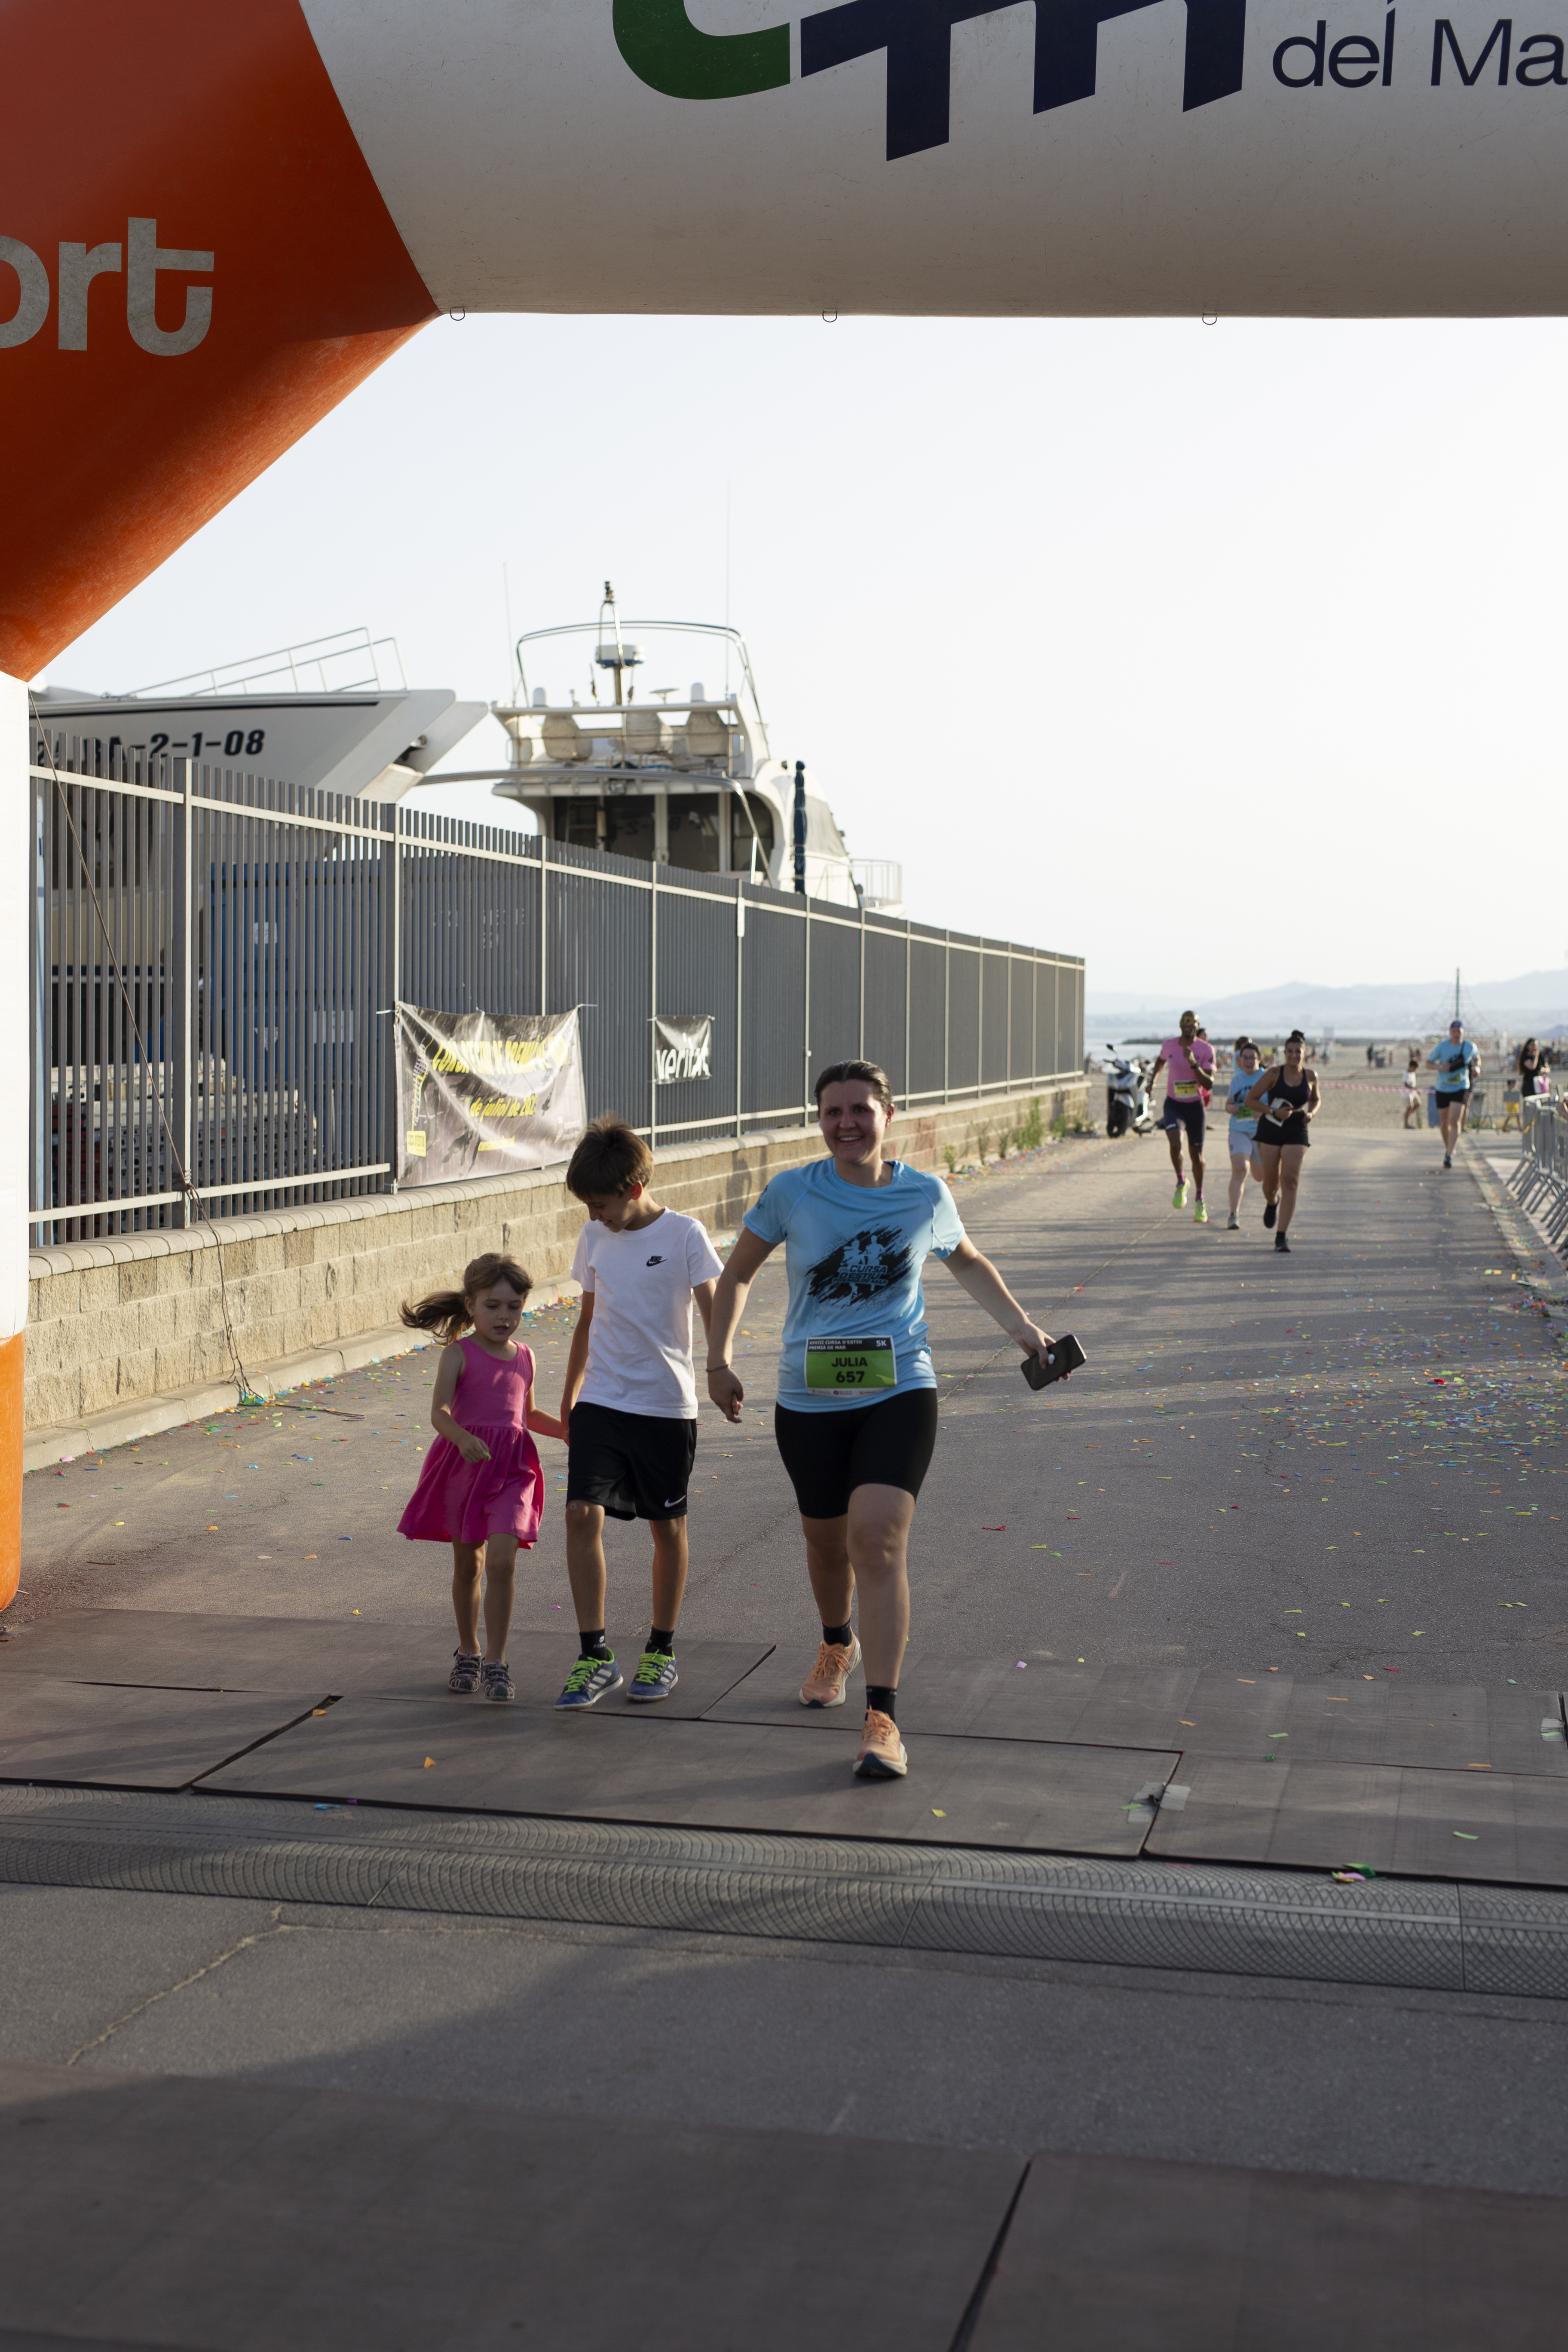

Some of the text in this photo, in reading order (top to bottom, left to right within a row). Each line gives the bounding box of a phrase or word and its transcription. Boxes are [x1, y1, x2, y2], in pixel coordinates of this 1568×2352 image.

[1272, 0, 1396, 88] del
[470, 1097, 483, 1117] de
[479, 1097, 512, 1123] juliol
[508, 1097, 521, 1117] de
[849, 1265, 886, 1273] CURSA
[831, 1357, 868, 1367] JULIA
[836, 1371, 865, 1383] 657
